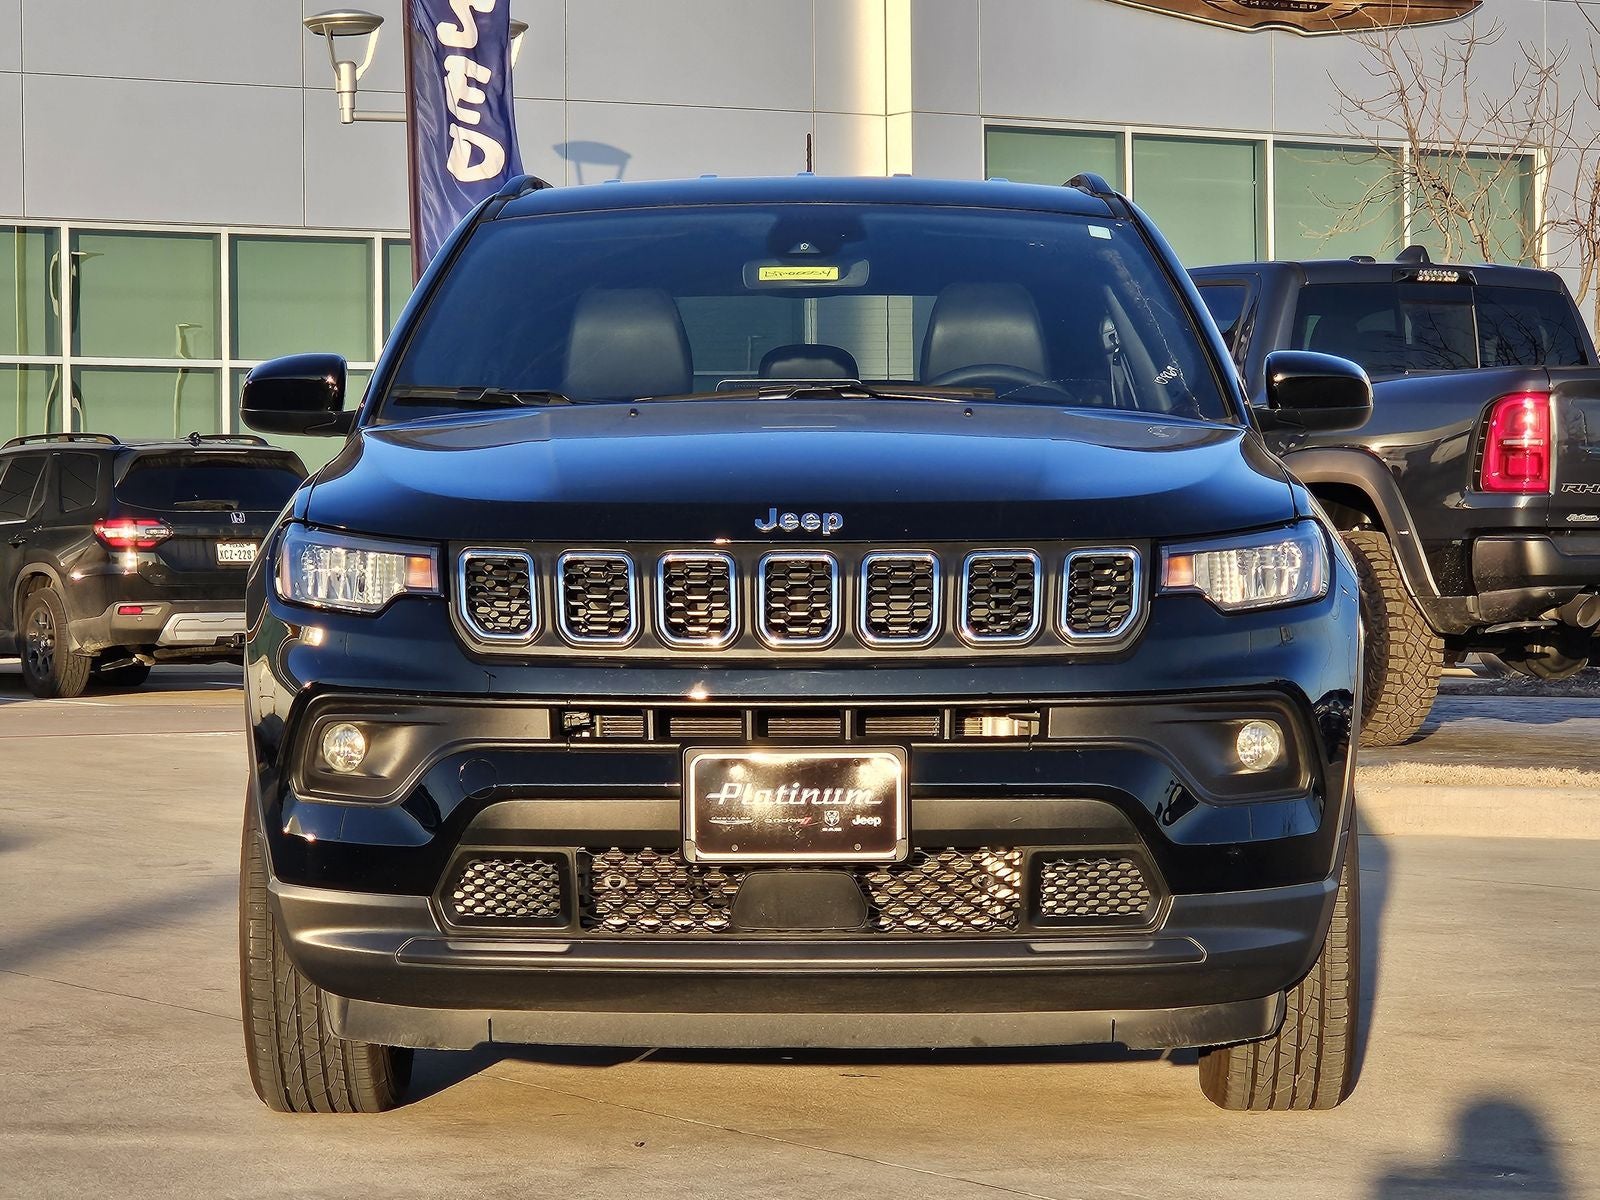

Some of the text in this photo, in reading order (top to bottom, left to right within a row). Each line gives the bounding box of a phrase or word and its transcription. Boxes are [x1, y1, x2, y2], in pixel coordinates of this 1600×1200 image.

[754, 507, 844, 536] Jeep
[705, 781, 883, 806] Platinum
[852, 814, 882, 827] Jeep
